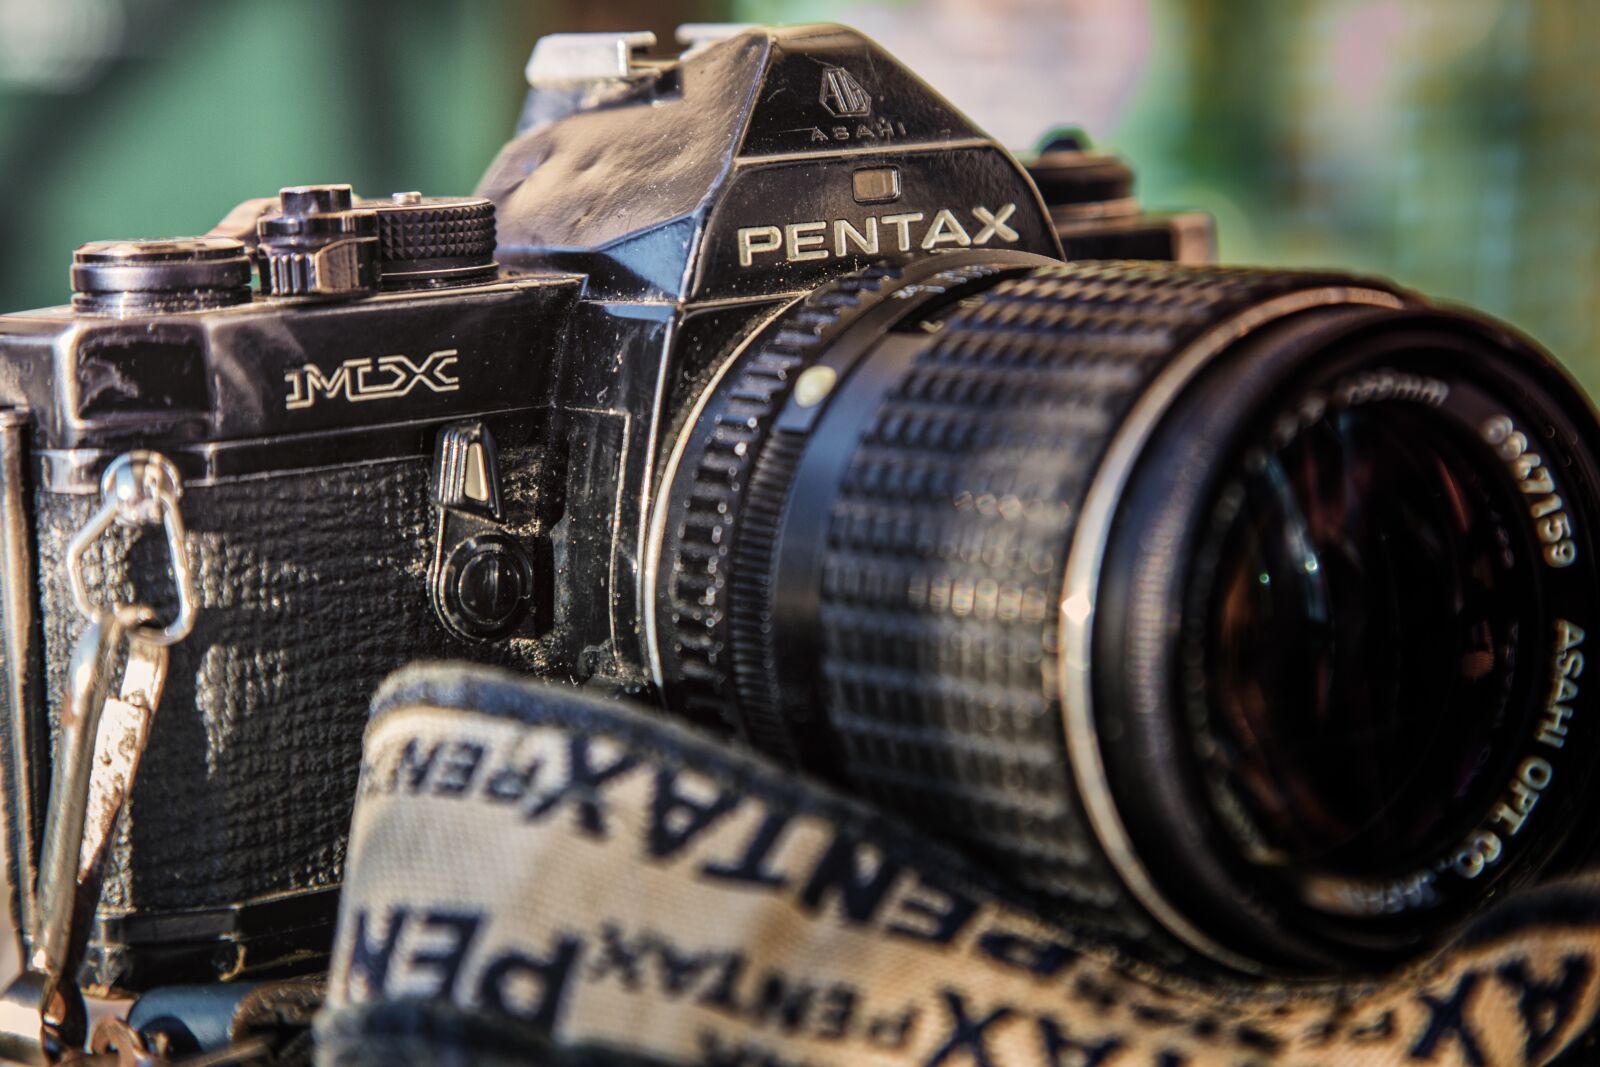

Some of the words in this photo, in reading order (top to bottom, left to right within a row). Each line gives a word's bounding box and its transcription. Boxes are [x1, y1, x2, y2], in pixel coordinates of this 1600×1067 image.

[811, 119, 906, 142] ASAHI
[737, 203, 1020, 267] PENTAX
[1534, 618, 1586, 749] ASAHI
